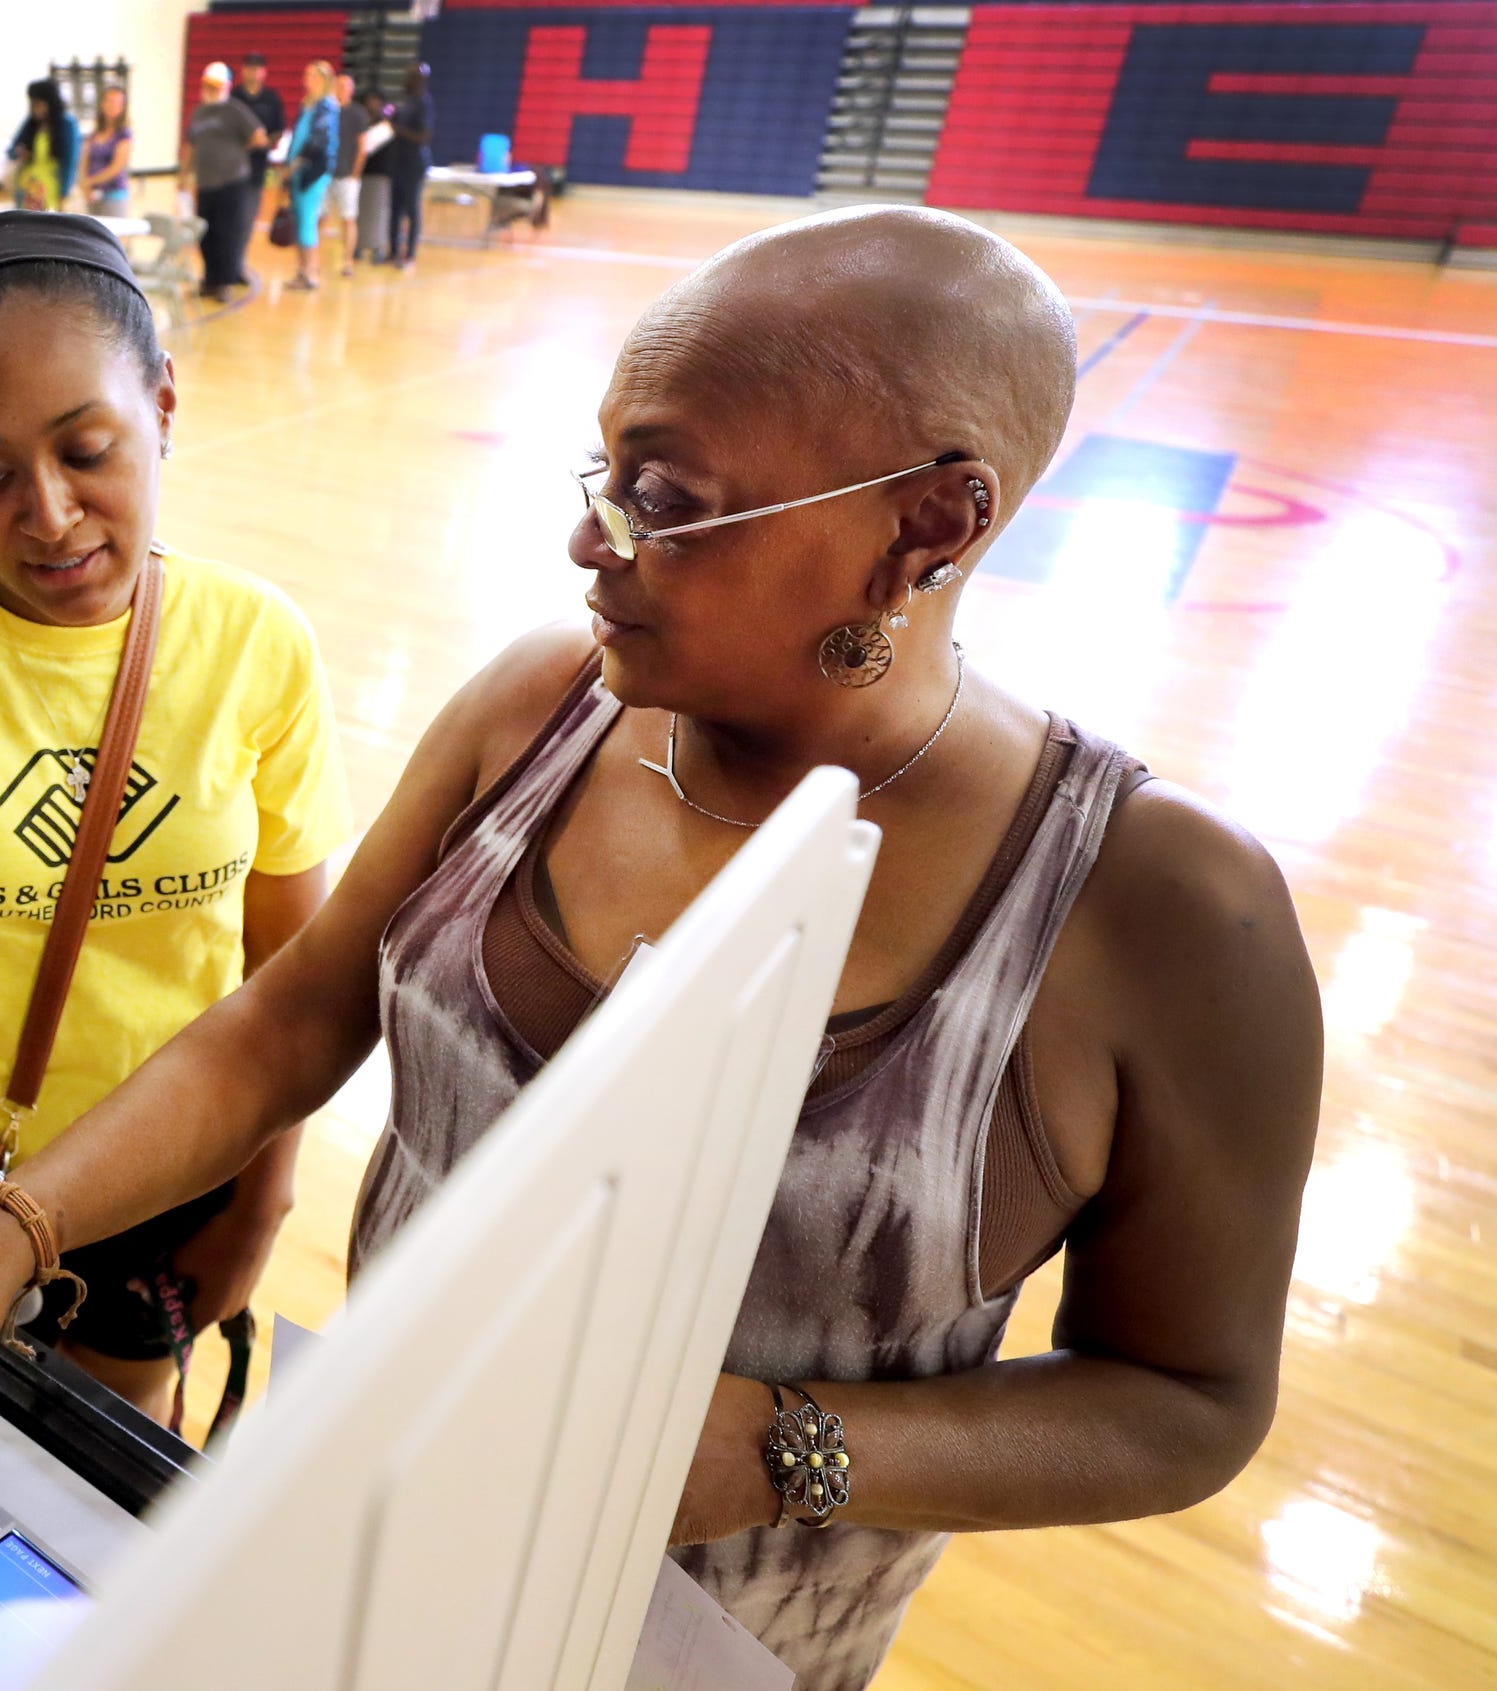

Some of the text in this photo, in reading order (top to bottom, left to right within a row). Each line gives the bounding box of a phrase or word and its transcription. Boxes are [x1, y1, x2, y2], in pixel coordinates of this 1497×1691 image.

[513, 23, 1426, 213] H E
[15, 885, 39, 905] &
[46, 878, 143, 902] GLS
[154, 851, 248, 897] CLUBS
[140, 884, 229, 913] COUNTY
[6, 1541, 51, 1578] NEXT PAGE
